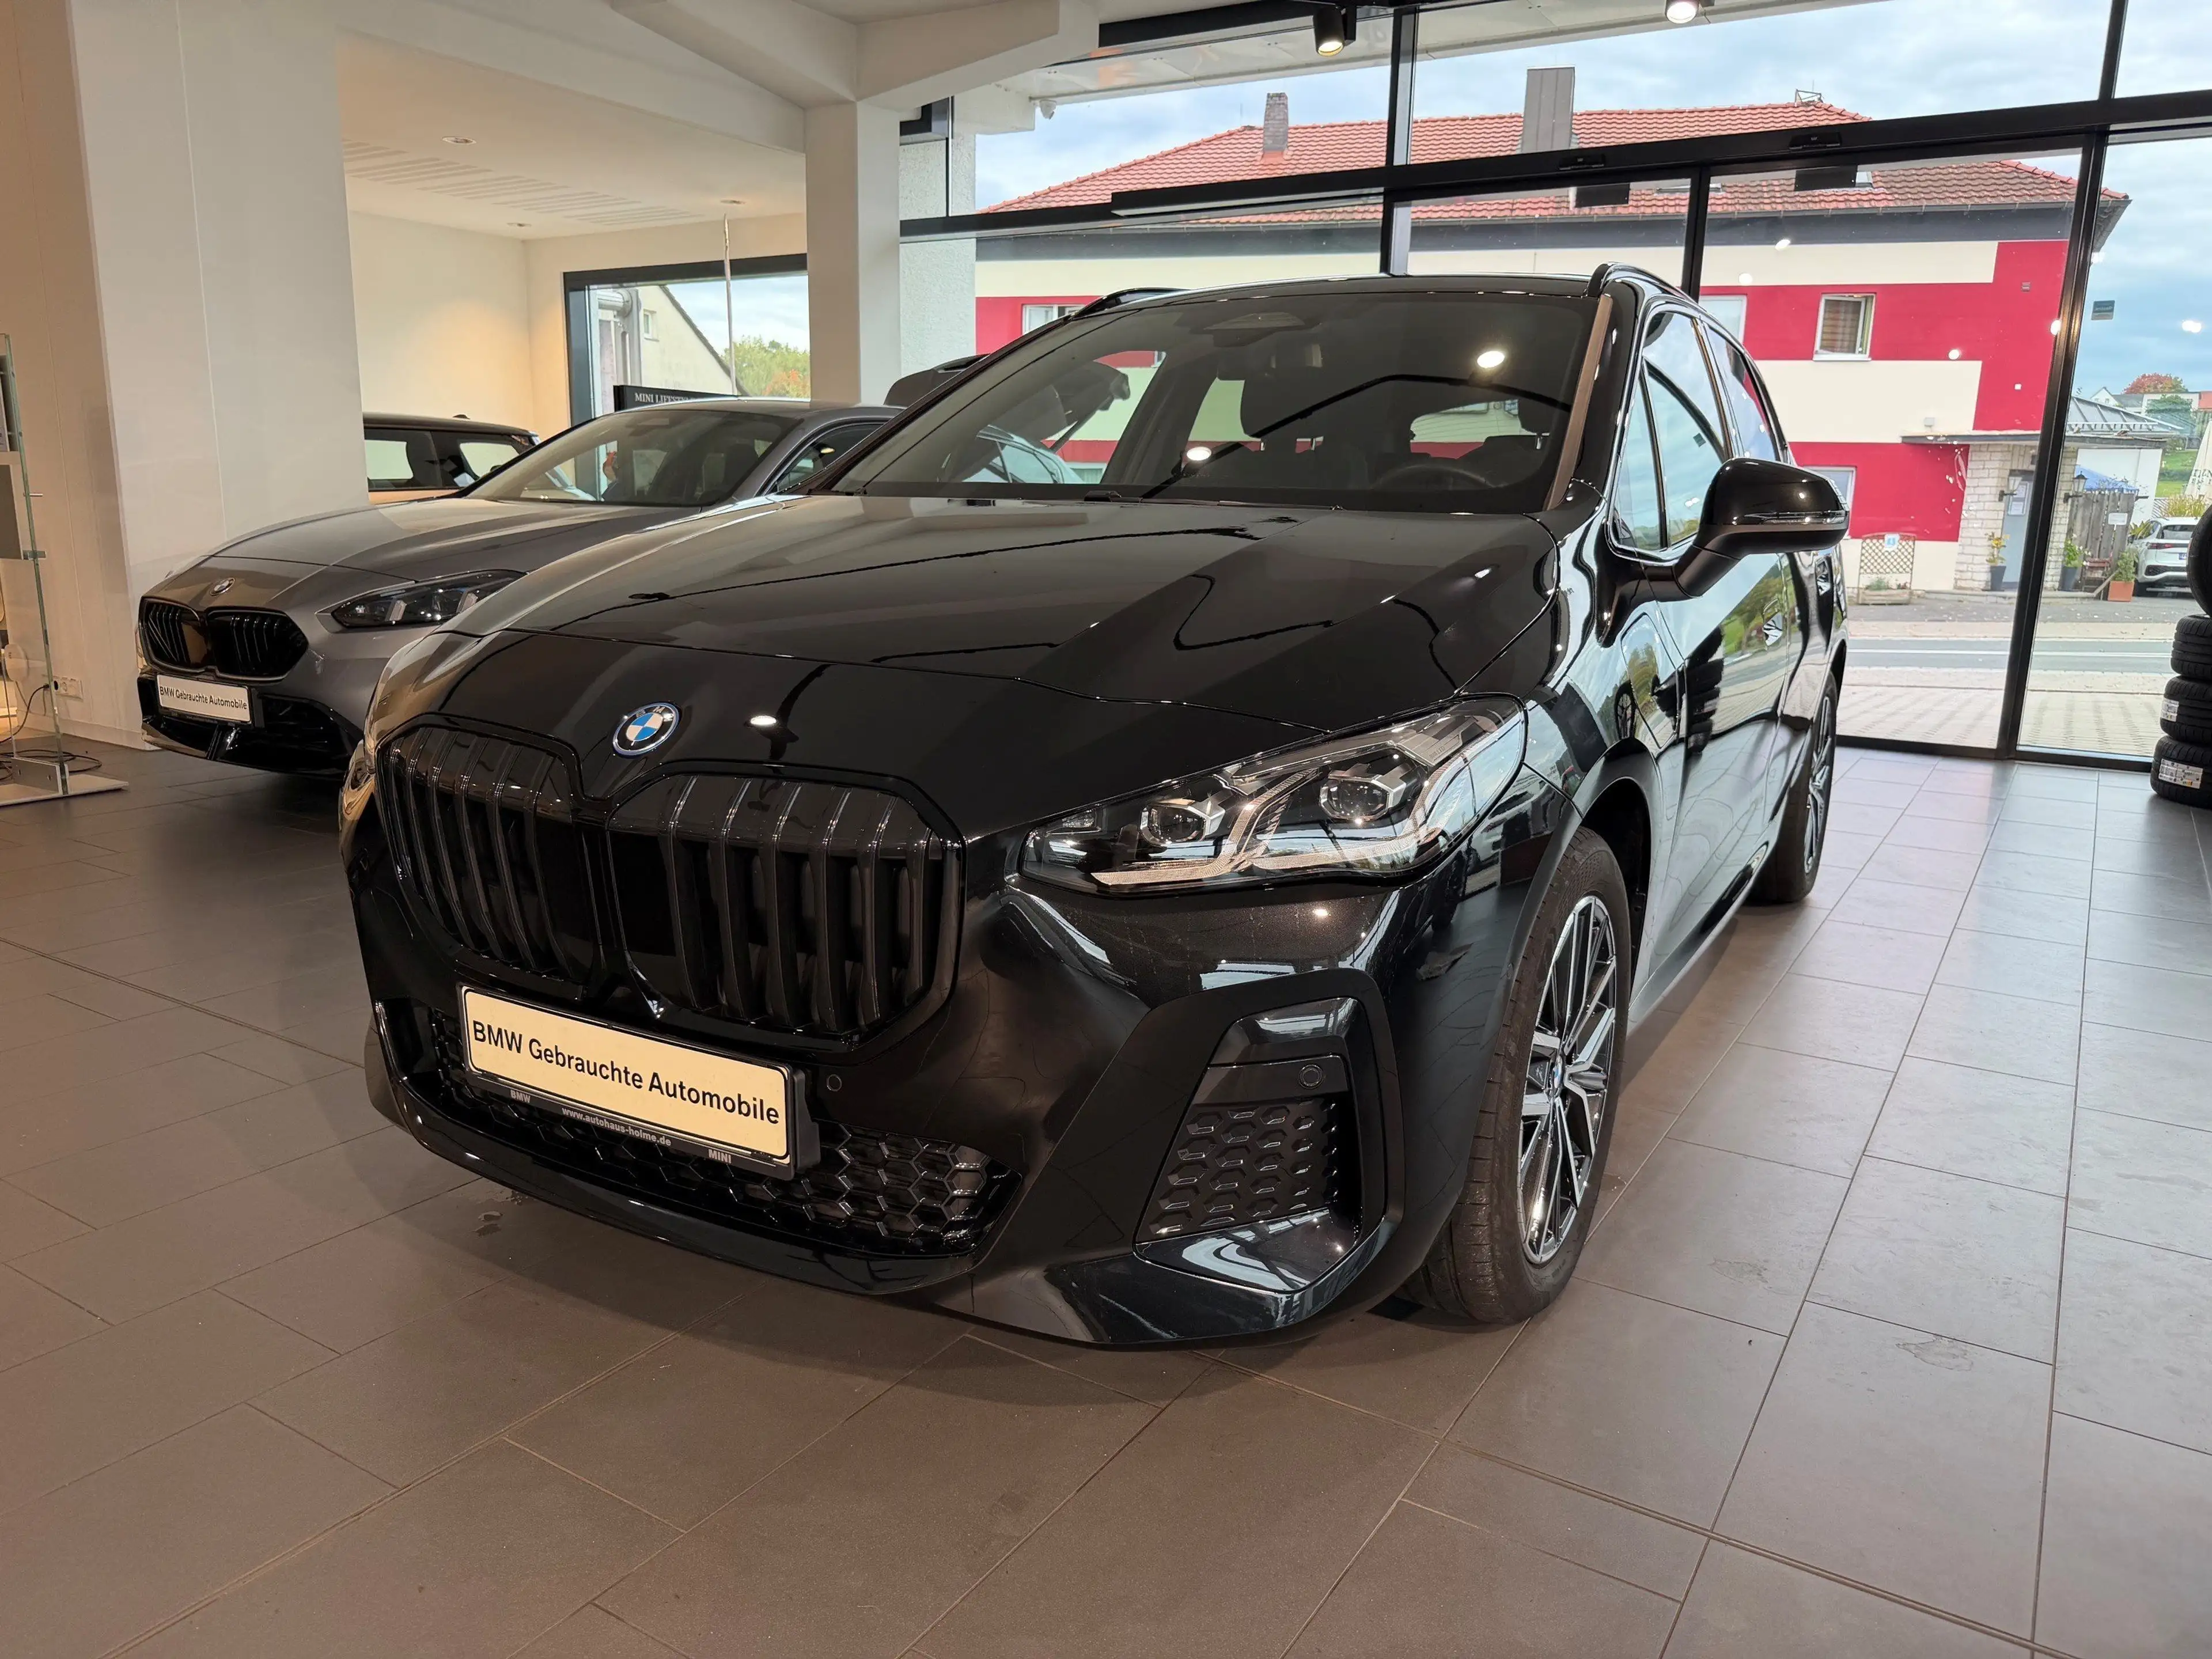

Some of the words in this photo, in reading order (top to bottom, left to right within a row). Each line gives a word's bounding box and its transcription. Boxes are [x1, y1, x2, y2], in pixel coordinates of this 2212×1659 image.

[635, 392, 654, 403] MINI
[160, 687, 174, 698] BMW
[176, 690, 208, 703] Gebrauchte
[210, 696, 247, 709] Automobile
[472, 1020, 523, 1054] BMW
[528, 1039, 643, 1089] Gebrauchte
[648, 1071, 780, 1124] Automobile
[510, 1089, 531, 1104] BMW
[562, 1107, 672, 1147] www.autohaus-holme.de
[708, 1149, 732, 1164] MINI
